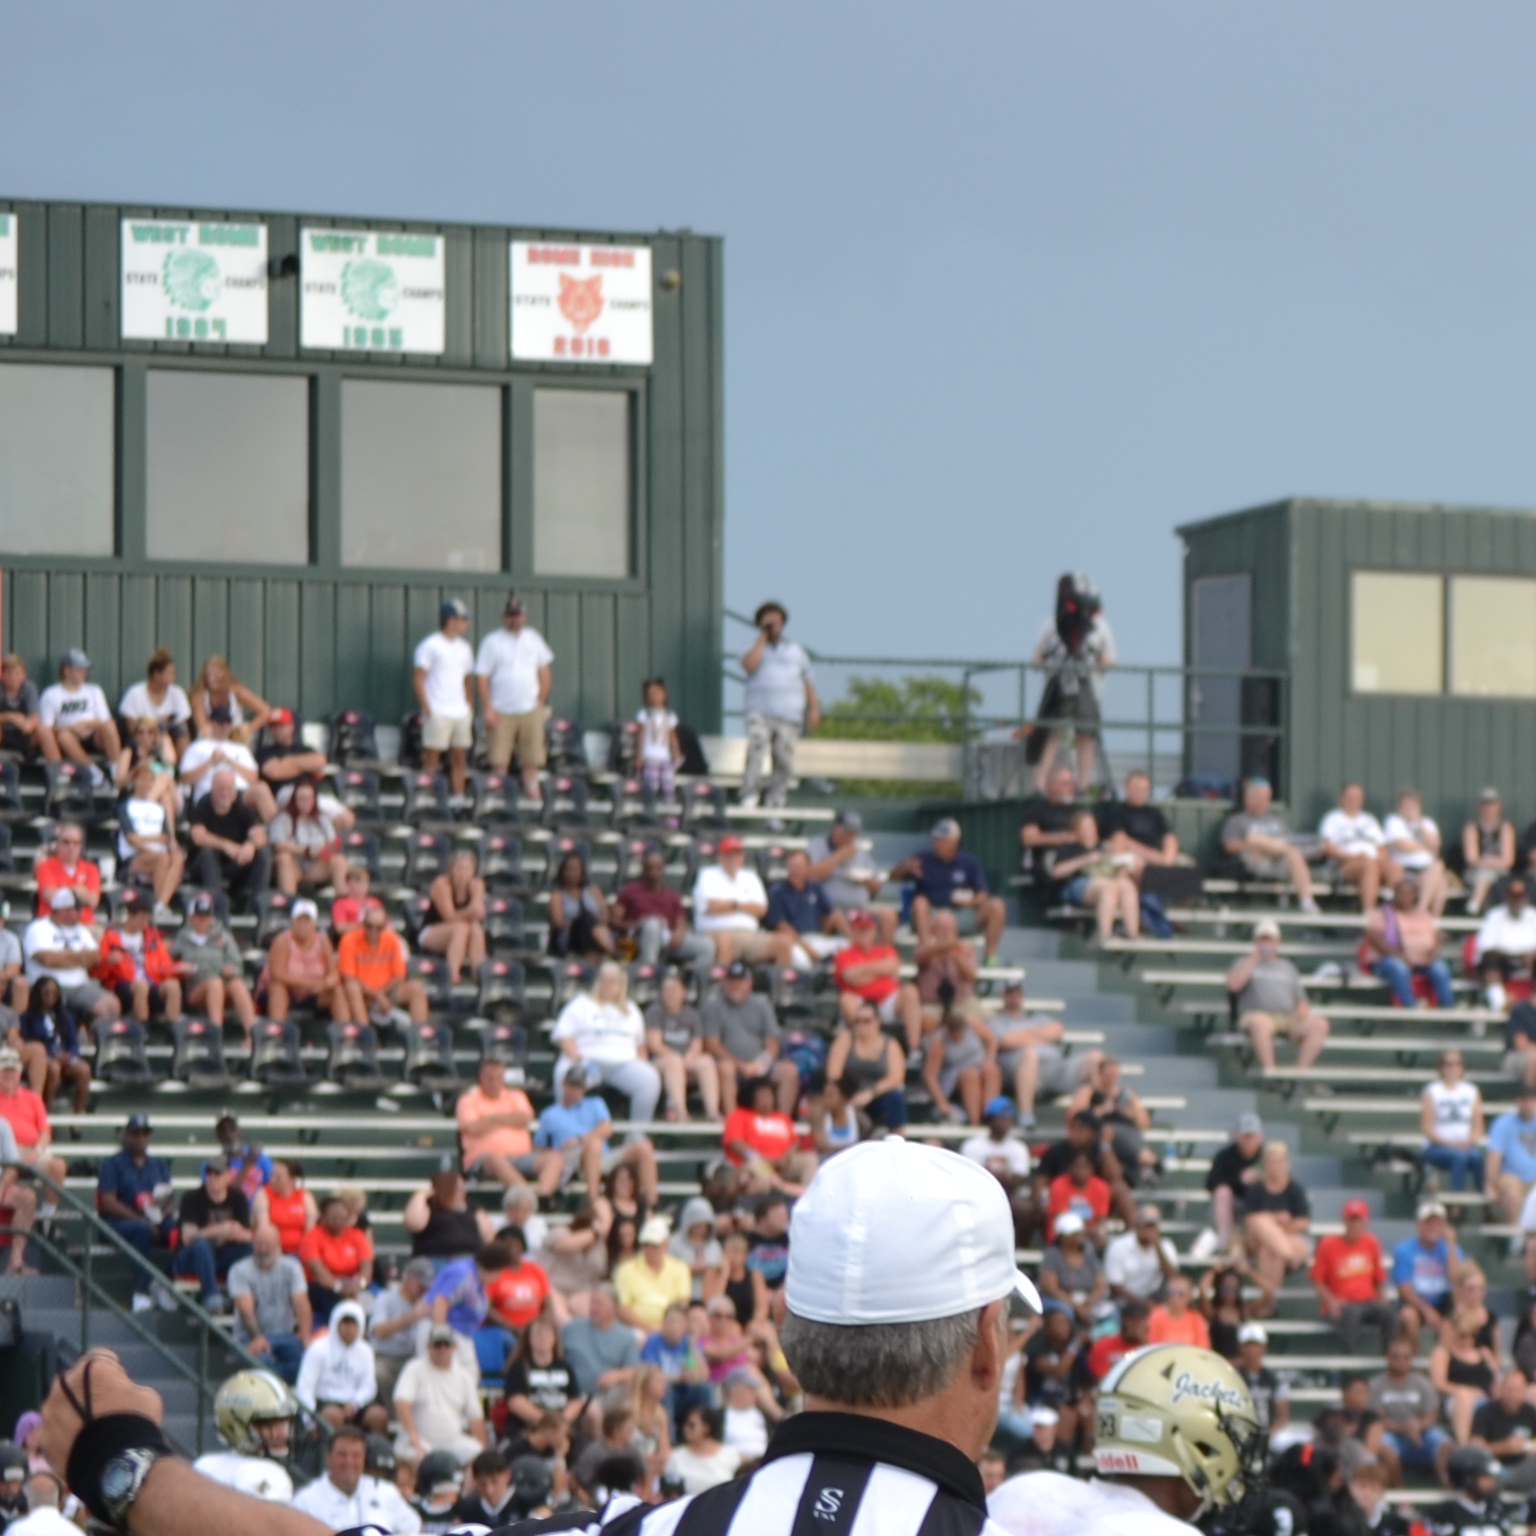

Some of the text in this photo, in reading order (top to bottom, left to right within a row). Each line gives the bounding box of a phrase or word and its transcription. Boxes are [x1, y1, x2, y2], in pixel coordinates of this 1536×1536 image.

[131, 224, 260, 247] WEST ROME
[310, 234, 436, 258] WEST ROME
[527, 246, 580, 265] ROME
[1172, 1370, 1243, 1410] Jackets
